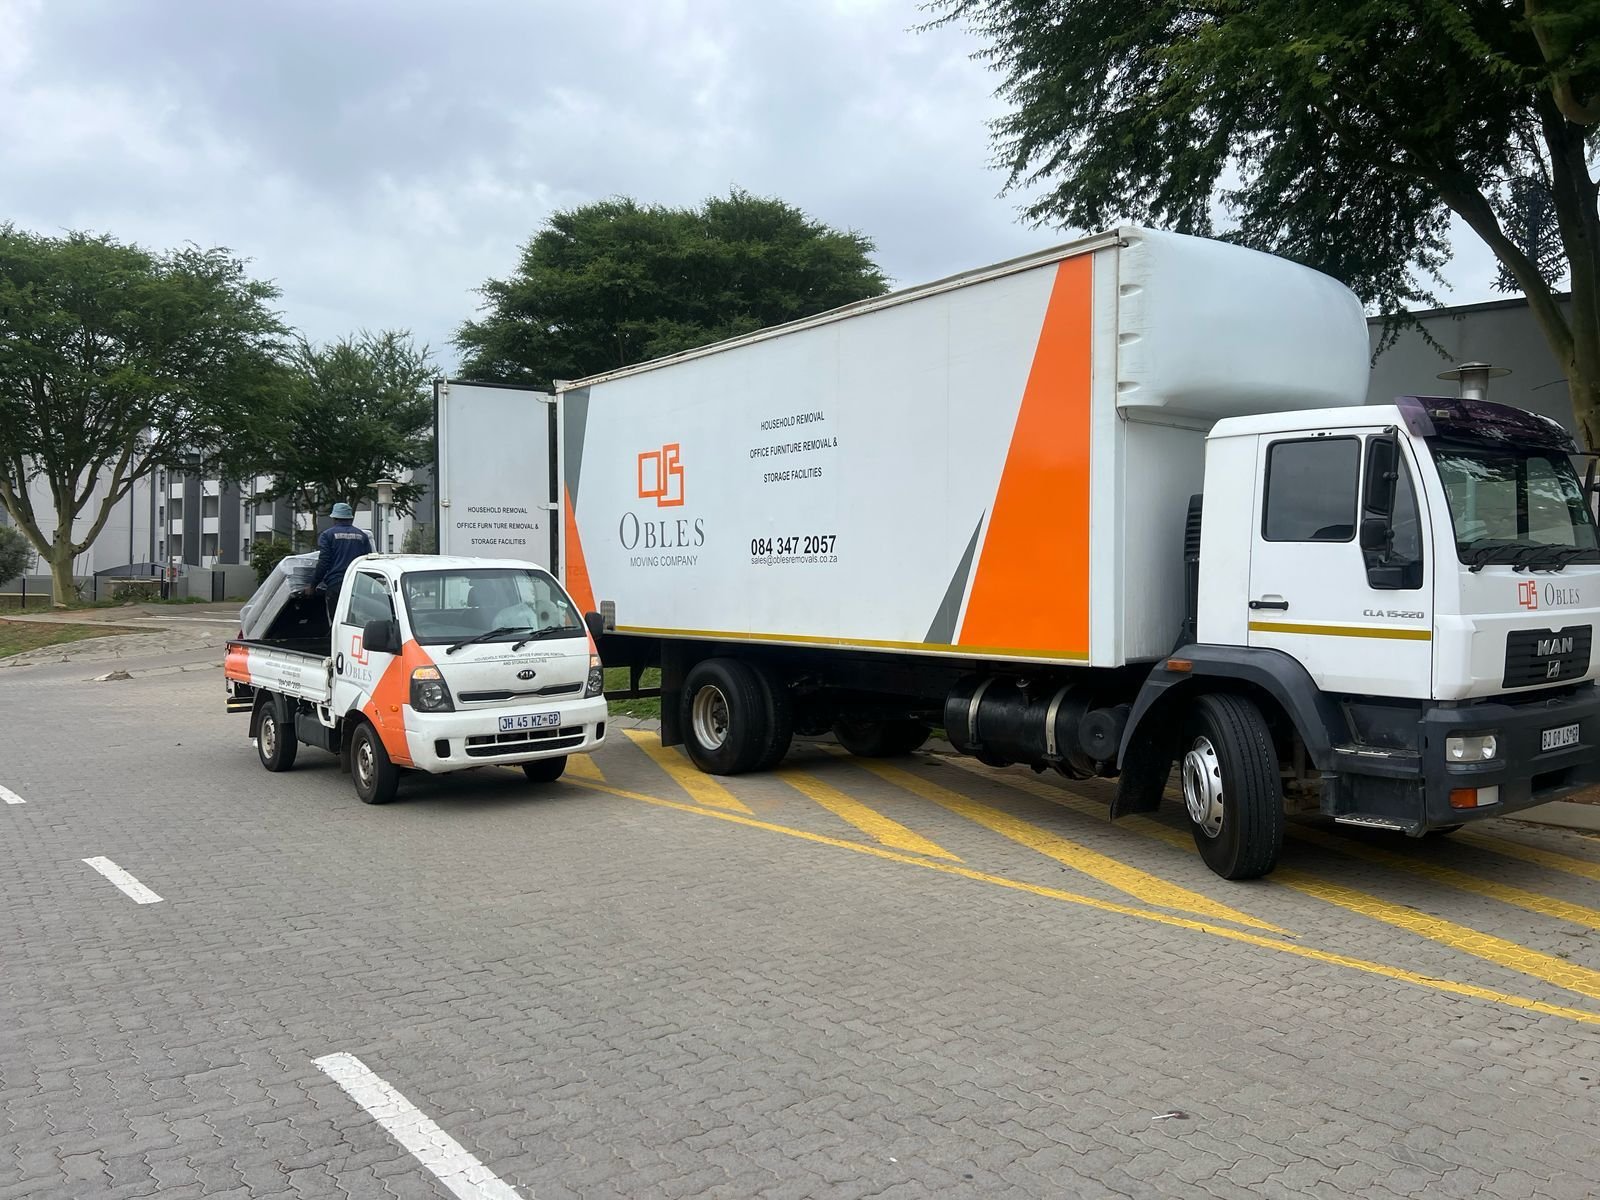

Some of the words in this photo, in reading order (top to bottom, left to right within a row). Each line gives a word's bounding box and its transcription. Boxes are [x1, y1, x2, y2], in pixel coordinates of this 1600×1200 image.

[760, 416, 795, 431] HOUSEHOLD
[796, 411, 825, 425] REMOVAL
[749, 447, 769, 459] OFFICE
[770, 442, 802, 456] FURNITURE
[803, 438, 832, 452] REMOVAL
[832, 436, 838, 447] &
[763, 471, 790, 483] STORAGE
[791, 466, 823, 480] FACILITIES
[751, 537, 773, 556] 084
[776, 536, 800, 555] 347
[803, 535, 837, 554] 2057
[630, 556, 659, 567] MOVING
[660, 555, 698, 567] COMPANY
[1363, 609, 1384, 617] CLA
[1386, 610, 1425, 619] 15-220
[1537, 637, 1573, 657] MAN
[519, 671, 534, 679] KIA
[502, 718, 514, 729] JH
[517, 716, 528, 727] 45
[531, 715, 542, 726] MZ
[548, 713, 558, 725] GP
